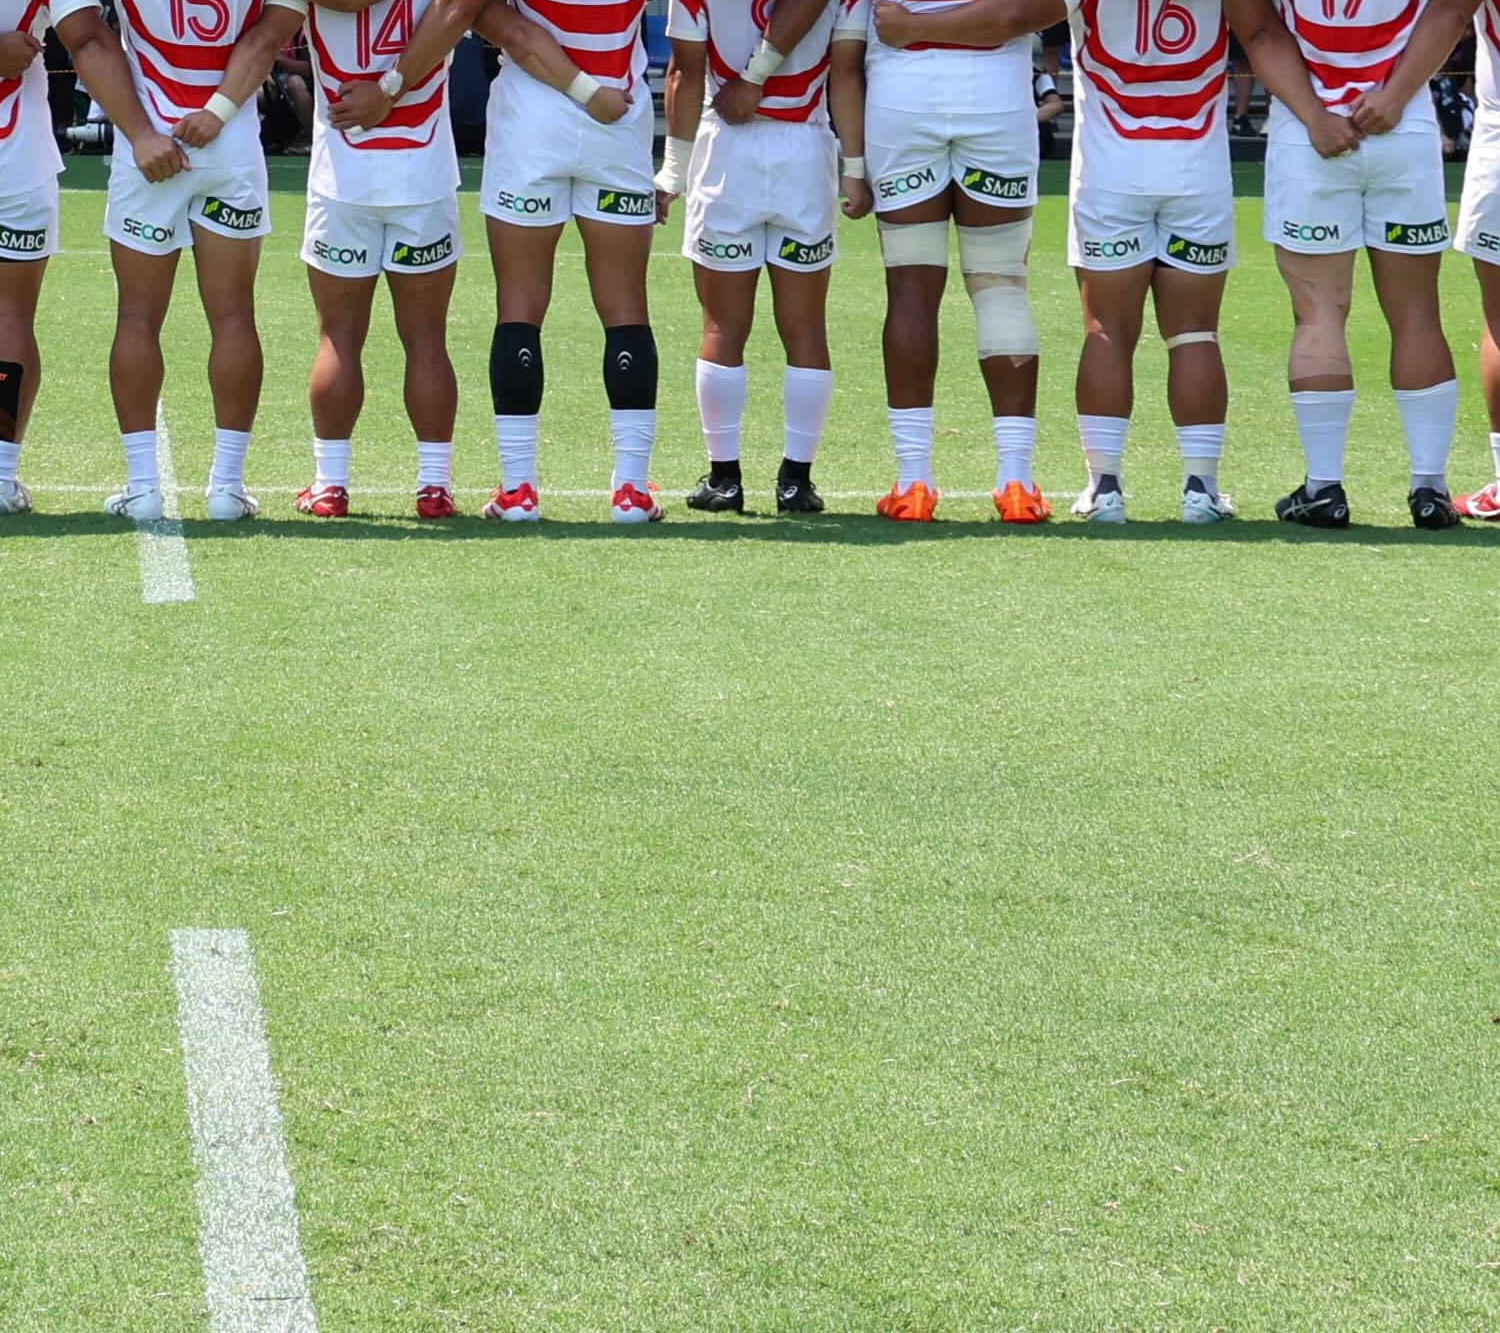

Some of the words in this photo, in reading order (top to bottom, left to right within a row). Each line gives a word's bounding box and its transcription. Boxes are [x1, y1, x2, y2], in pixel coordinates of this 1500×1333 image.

[879, 167, 936, 199] SECOM
[983, 173, 1027, 199] SMBC
[498, 191, 551, 214] SECOM
[218, 206, 262, 229] SMBC
[0, 228, 45, 251] SMBC
[123, 217, 174, 243] SECOM
[1283, 221, 1340, 241] SECOM
[314, 240, 367, 265] SECOM
[411, 240, 452, 265] SMBC
[698, 237, 752, 259] SECOM
[1085, 237, 1140, 258] SECOM
[1186, 242, 1228, 265] SMBC
